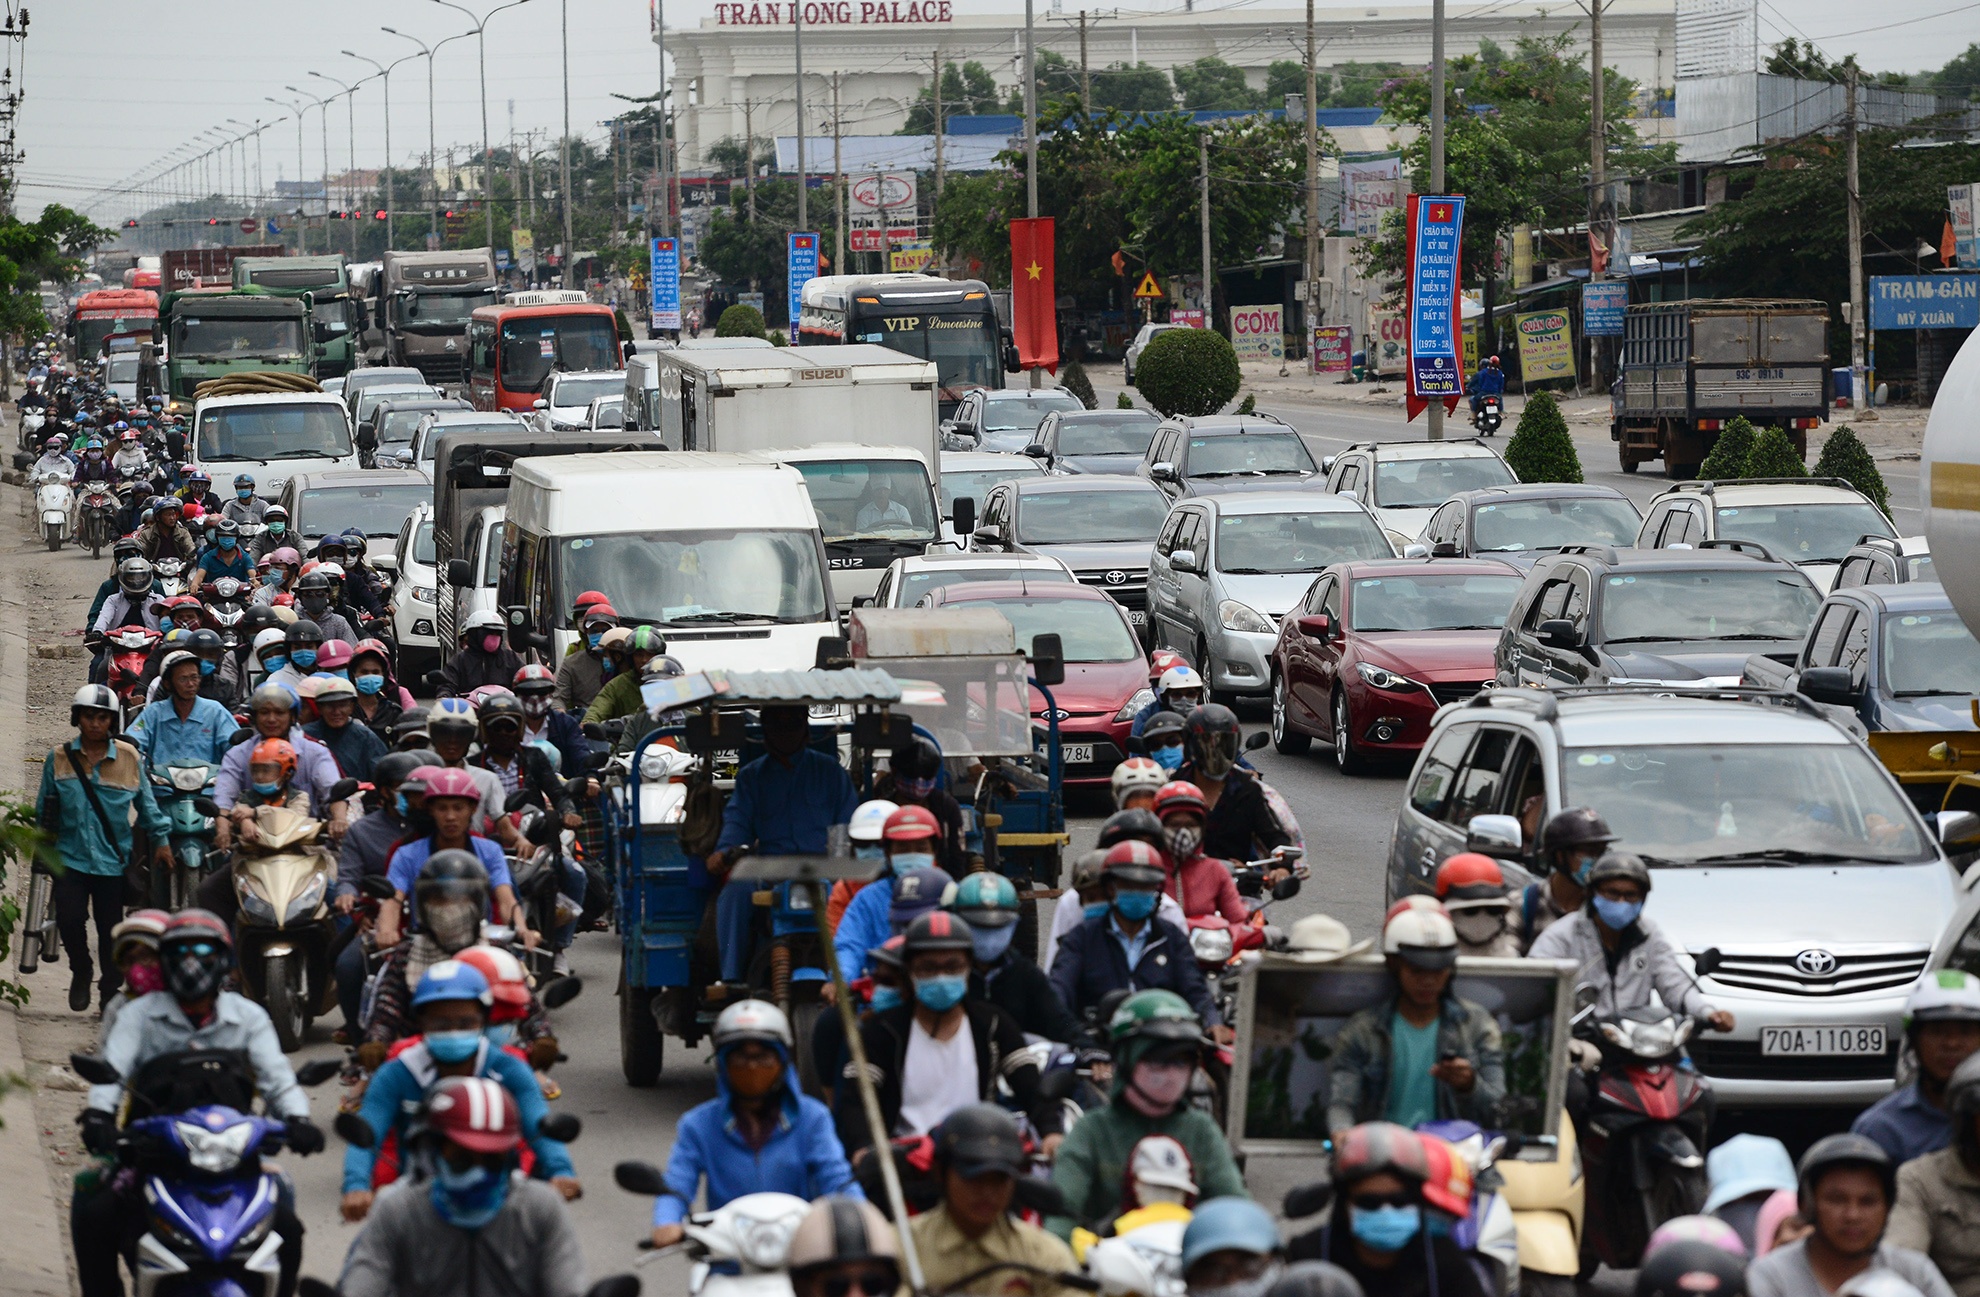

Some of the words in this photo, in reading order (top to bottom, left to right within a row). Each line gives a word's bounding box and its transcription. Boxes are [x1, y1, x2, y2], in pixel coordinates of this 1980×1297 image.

[788, 1, 850, 24] LONG
[860, 1, 953, 22] PALACE
[883, 317, 920, 332] VIP
[928, 316, 983, 329] Limousine
[1234, 308, 1279, 334] CƠM
[1522, 317, 1544, 333] QUÁN
[1897, 311, 1917, 325] MỸ
[1921, 310, 1955, 325] XUÂN
[801, 369, 844, 380] ISUZU
[1419, 372, 1442, 380] Quảng
[1736, 369, 1750, 380] 93C
[1421, 380, 1440, 390] Tam
[1767, 1030, 1883, 1052] 70A-110.89
